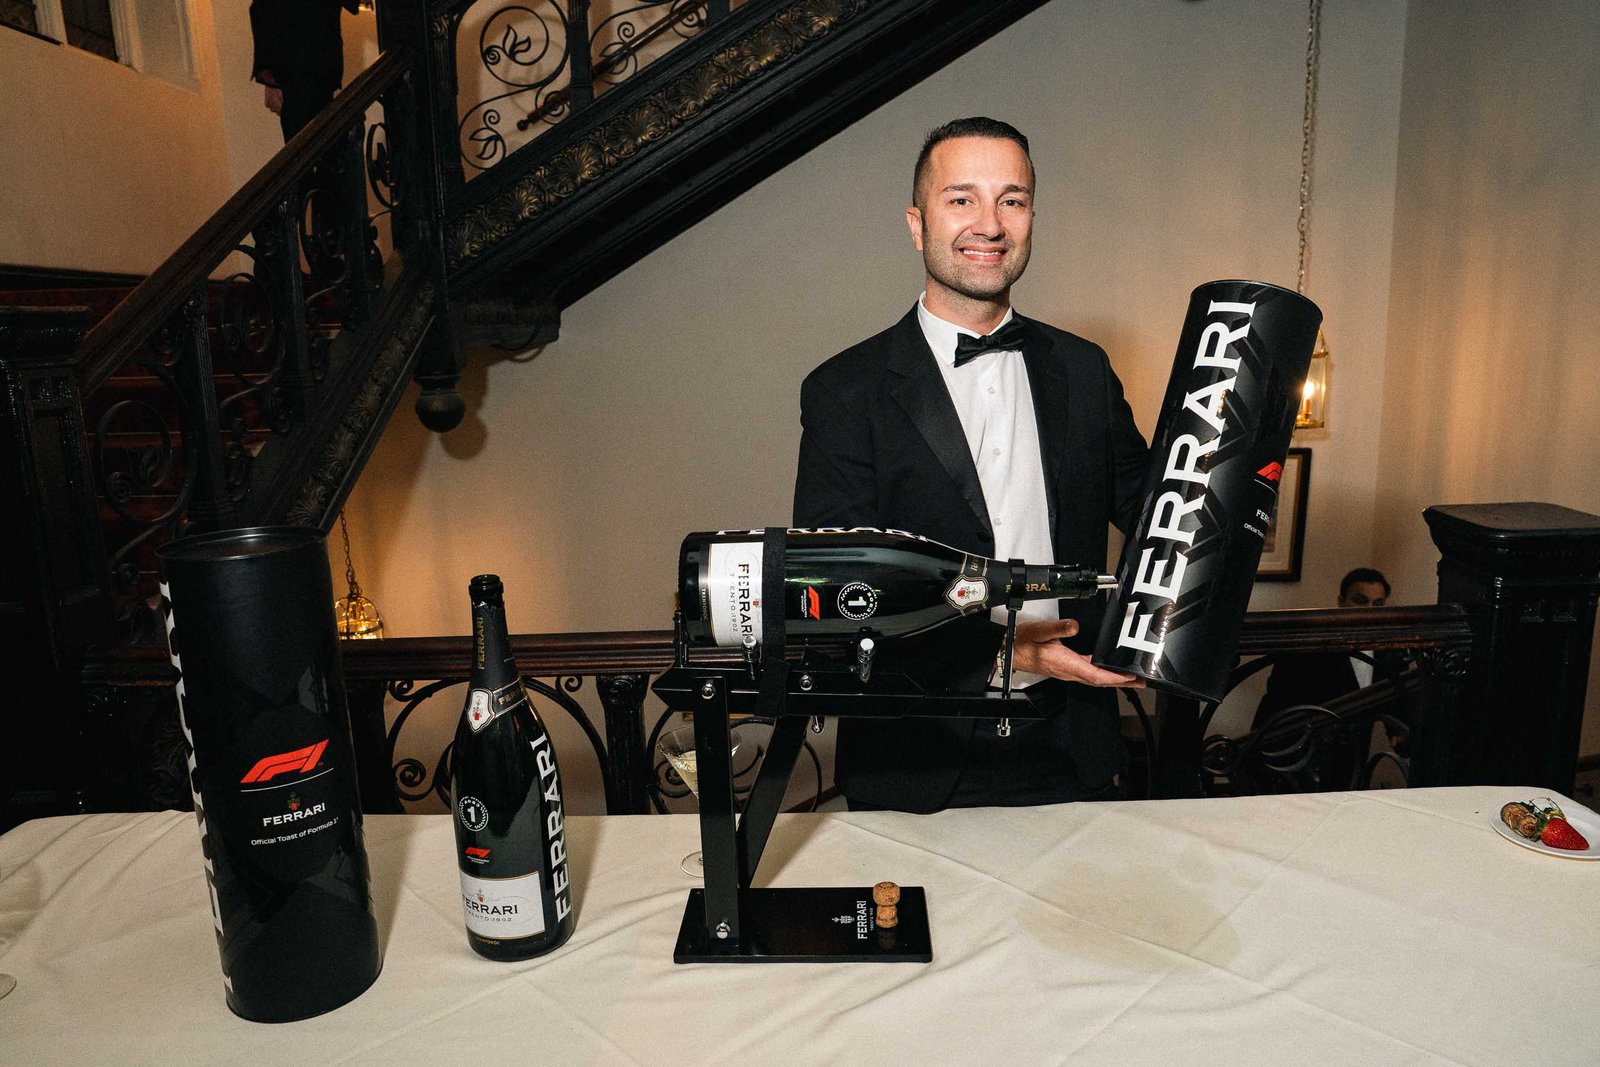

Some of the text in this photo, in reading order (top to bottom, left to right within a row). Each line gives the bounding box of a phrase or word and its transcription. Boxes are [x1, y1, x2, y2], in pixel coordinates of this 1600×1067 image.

[1117, 300, 1256, 655] FERRARI
[1005, 582, 1051, 593] FRRA
[847, 596, 868, 607] 1
[476, 617, 485, 670] FERRARI
[262, 802, 327, 827] FERRARI
[467, 806, 476, 823] 1
[250, 837, 277, 846] Official
[277, 833, 298, 843] Toast
[298, 830, 307, 838] of
[307, 821, 333, 835] Formula
[530, 732, 572, 923] FERRARI
[856, 900, 868, 940] FERRARI
